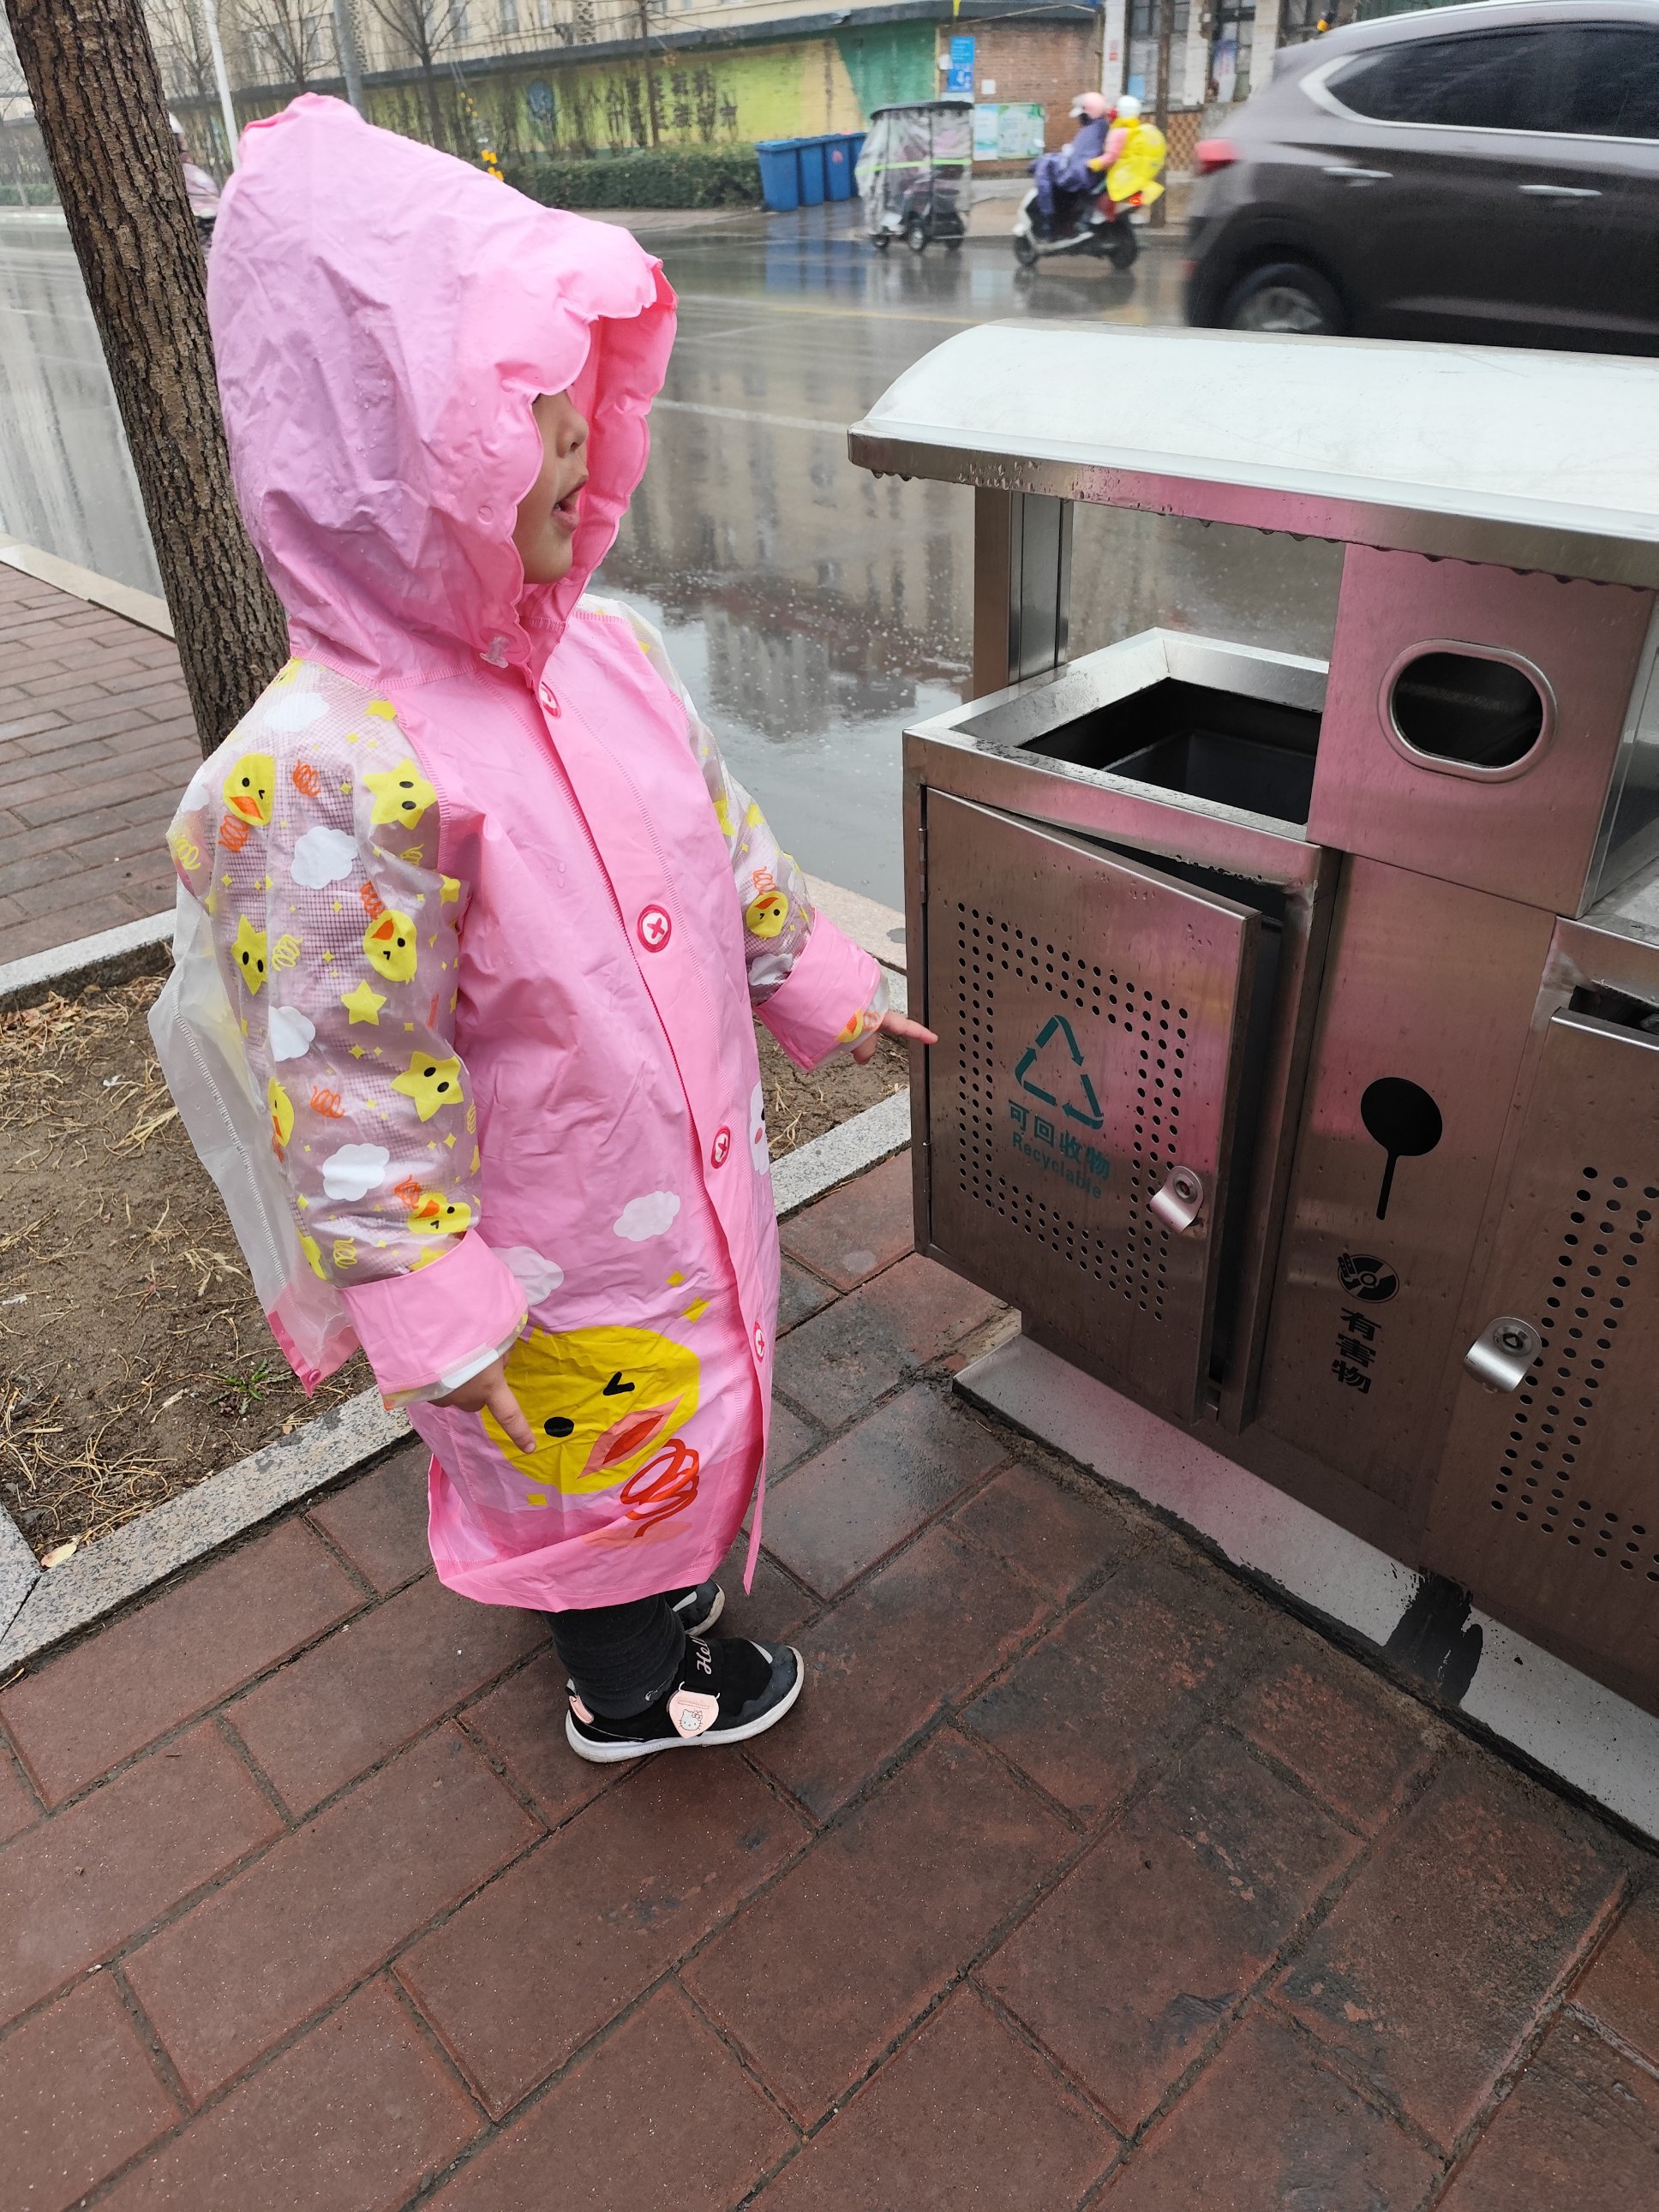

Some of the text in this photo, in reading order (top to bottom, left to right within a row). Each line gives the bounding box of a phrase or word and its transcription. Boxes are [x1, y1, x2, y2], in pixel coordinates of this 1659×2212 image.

[1009, 1099, 1110, 1181] 可回收物
[1012, 1131, 1102, 1199] Recyclable
[1332, 1307, 1382, 1394] 有害物
